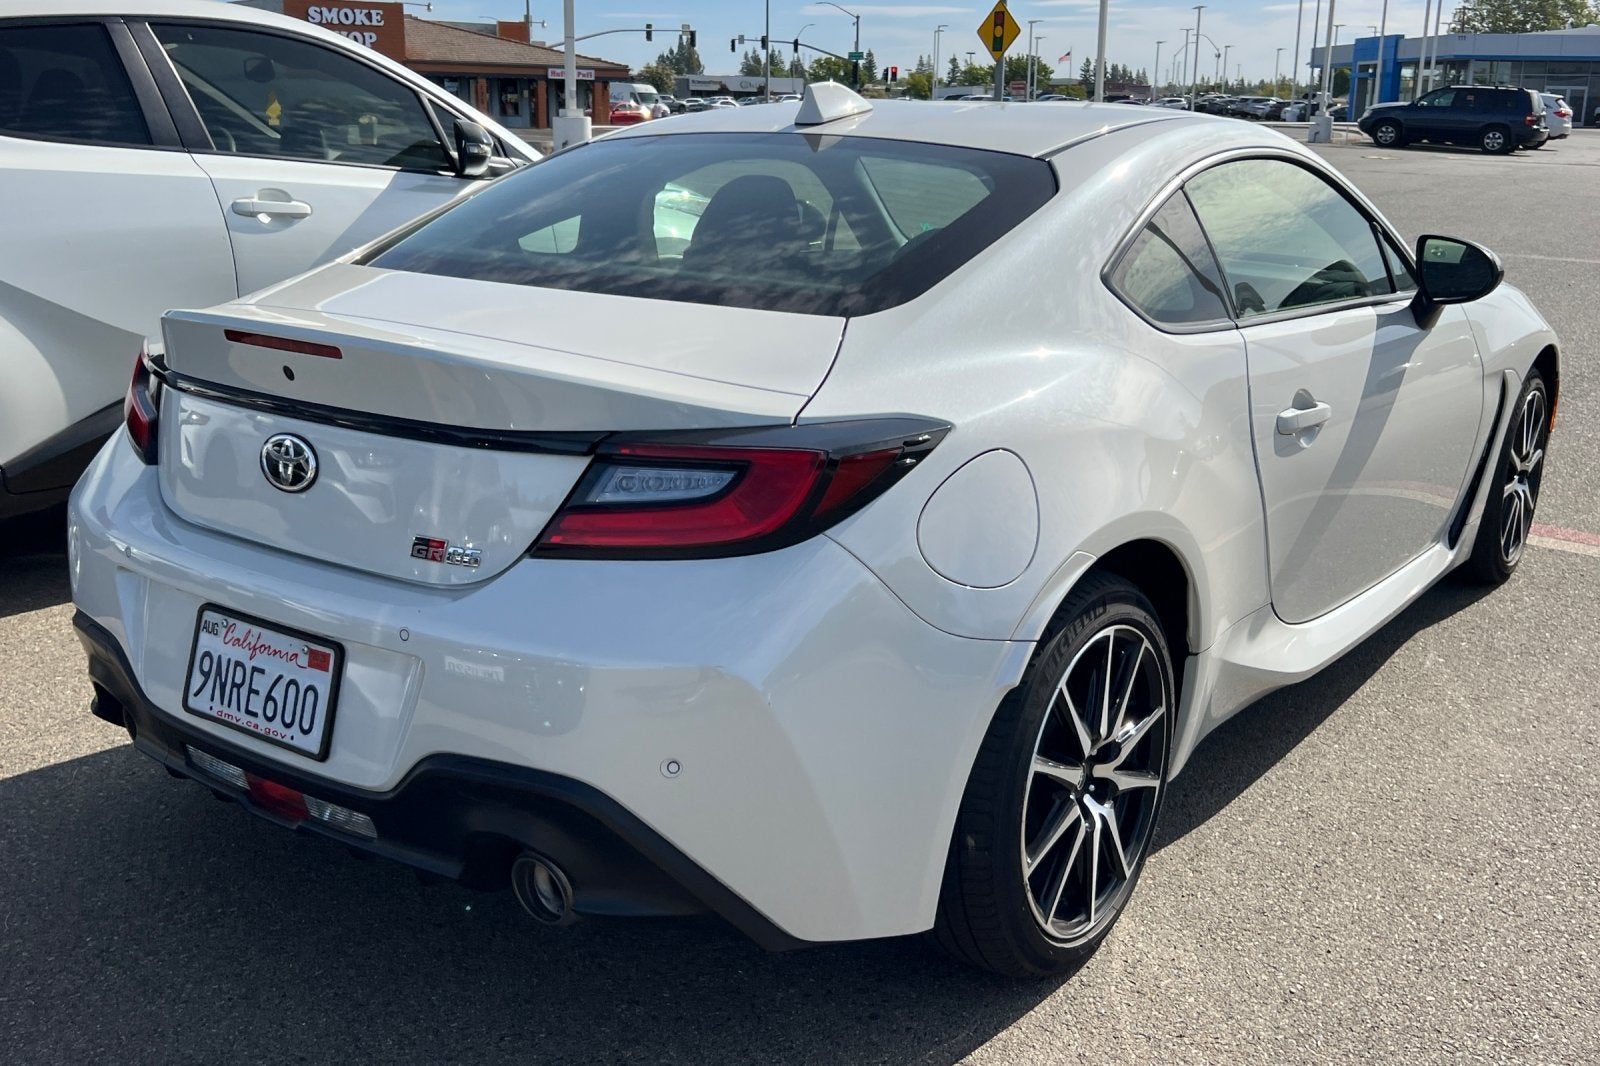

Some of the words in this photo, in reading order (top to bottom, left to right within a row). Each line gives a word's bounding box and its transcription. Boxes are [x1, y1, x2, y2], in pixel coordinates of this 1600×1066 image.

[308, 6, 384, 26] SMOKE
[334, 30, 377, 47] OP
[411, 540, 446, 562] GR
[202, 619, 219, 636] AUG
[223, 622, 308, 669] California
[193, 650, 319, 735] 9NRE600
[216, 710, 287, 739] dmv.ca.gov
